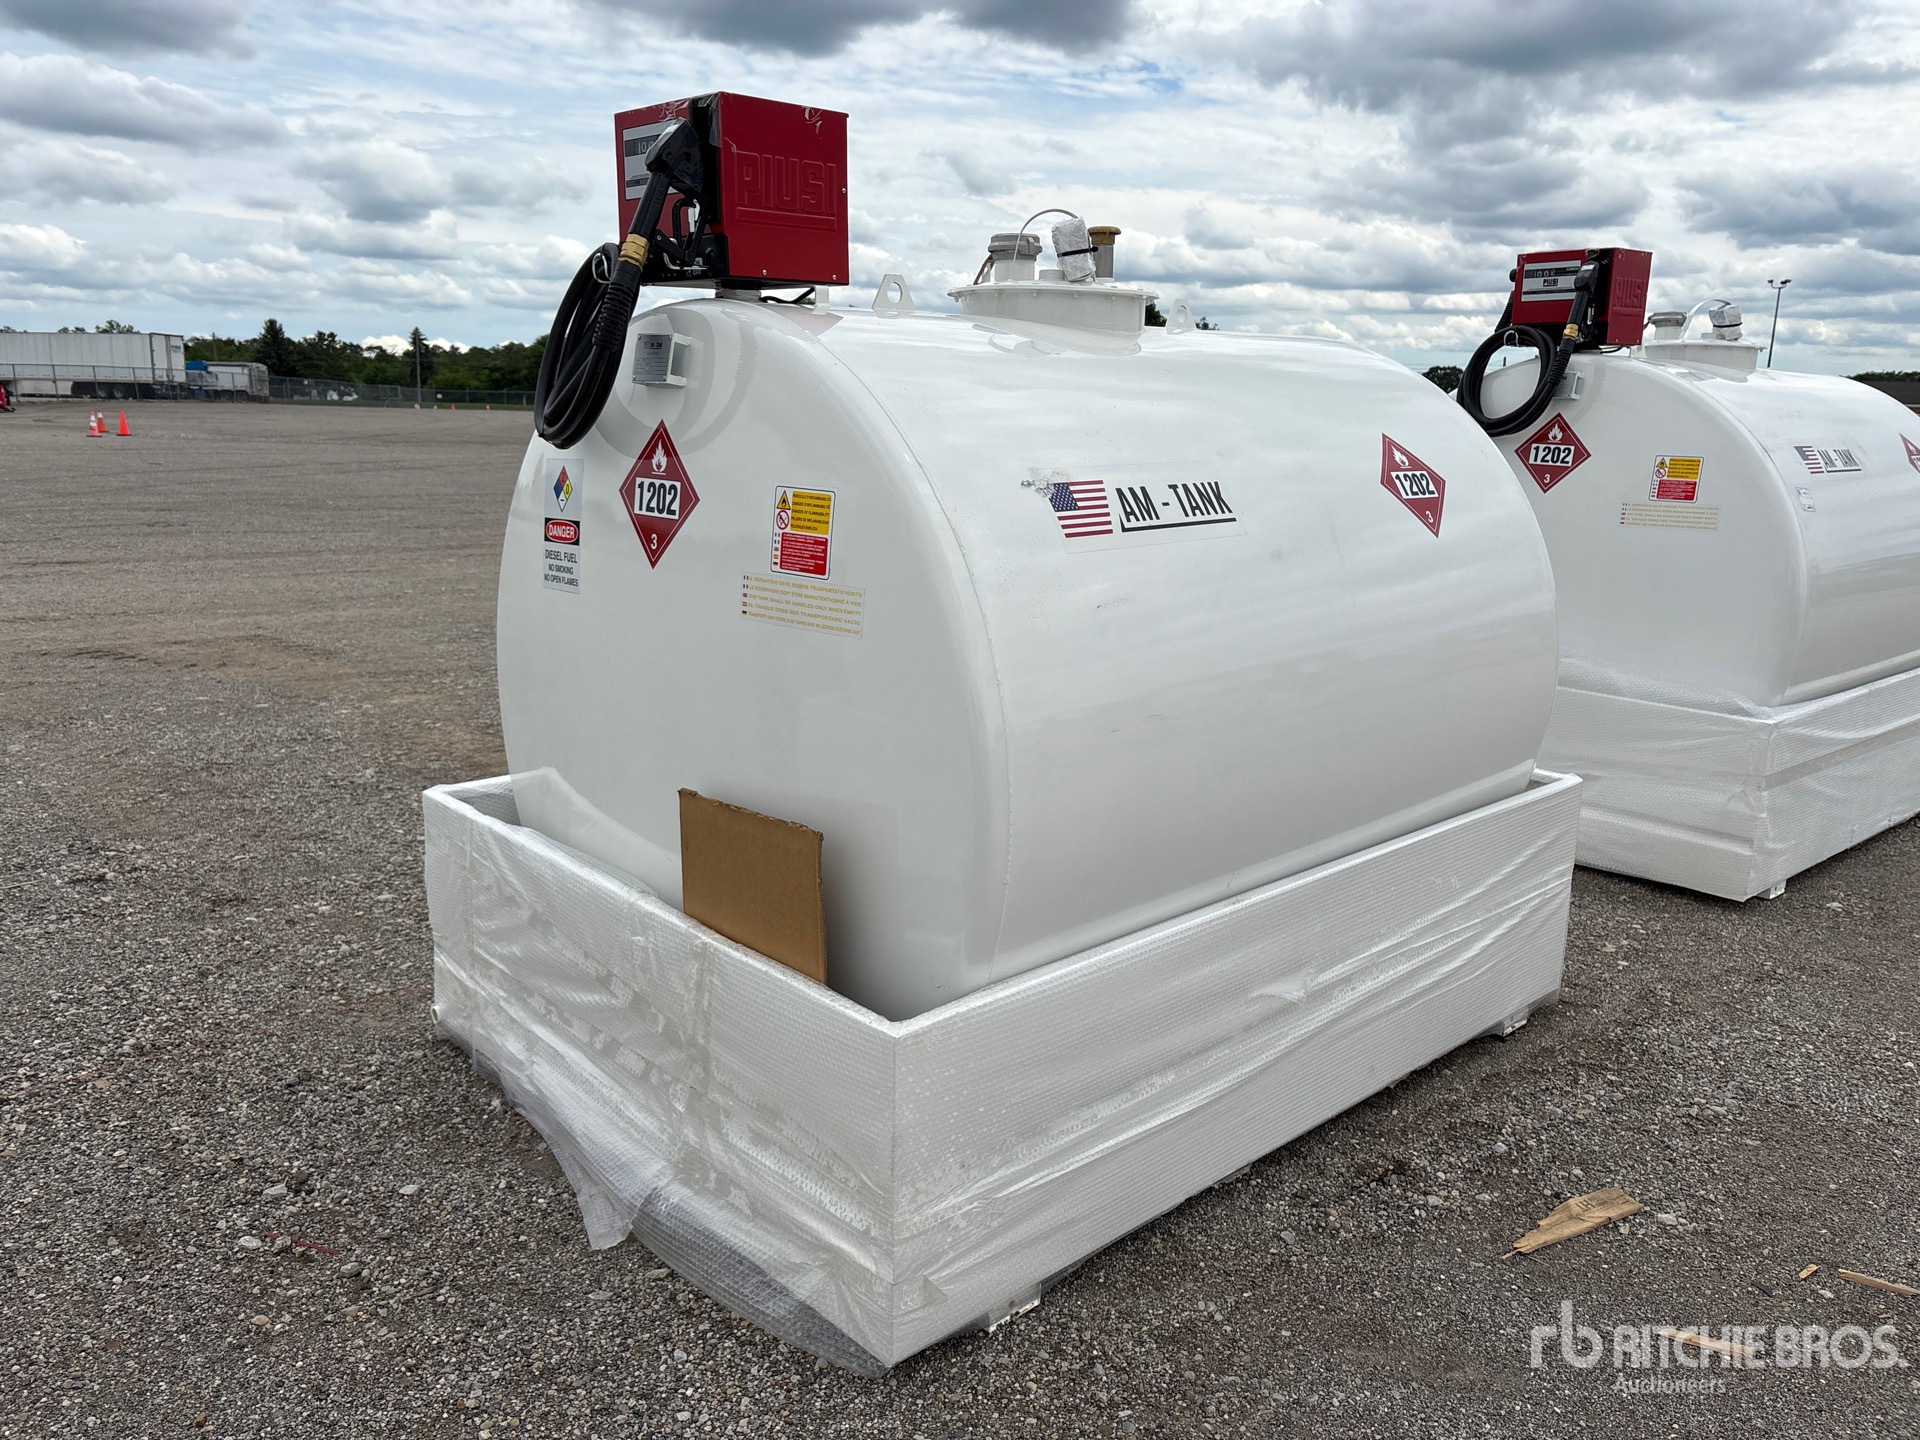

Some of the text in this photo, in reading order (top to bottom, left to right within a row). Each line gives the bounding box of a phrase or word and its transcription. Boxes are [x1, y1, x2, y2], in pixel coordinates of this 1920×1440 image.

[735, 149, 837, 217] PIUSI
[1532, 445, 1573, 465] 1202
[1394, 472, 1436, 497] 1202
[1543, 473, 1551, 484] 3
[565, 483, 570, 495] 0
[637, 480, 678, 516] 1202
[1425, 510, 1434, 523] 3
[548, 524, 575, 539] DANGER
[650, 533, 658, 550] 3
[545, 549, 578, 564] DIESEL FUEL
[548, 564, 574, 575] NO SMOKING
[544, 573, 579, 587] NO OPEN FLAMES
